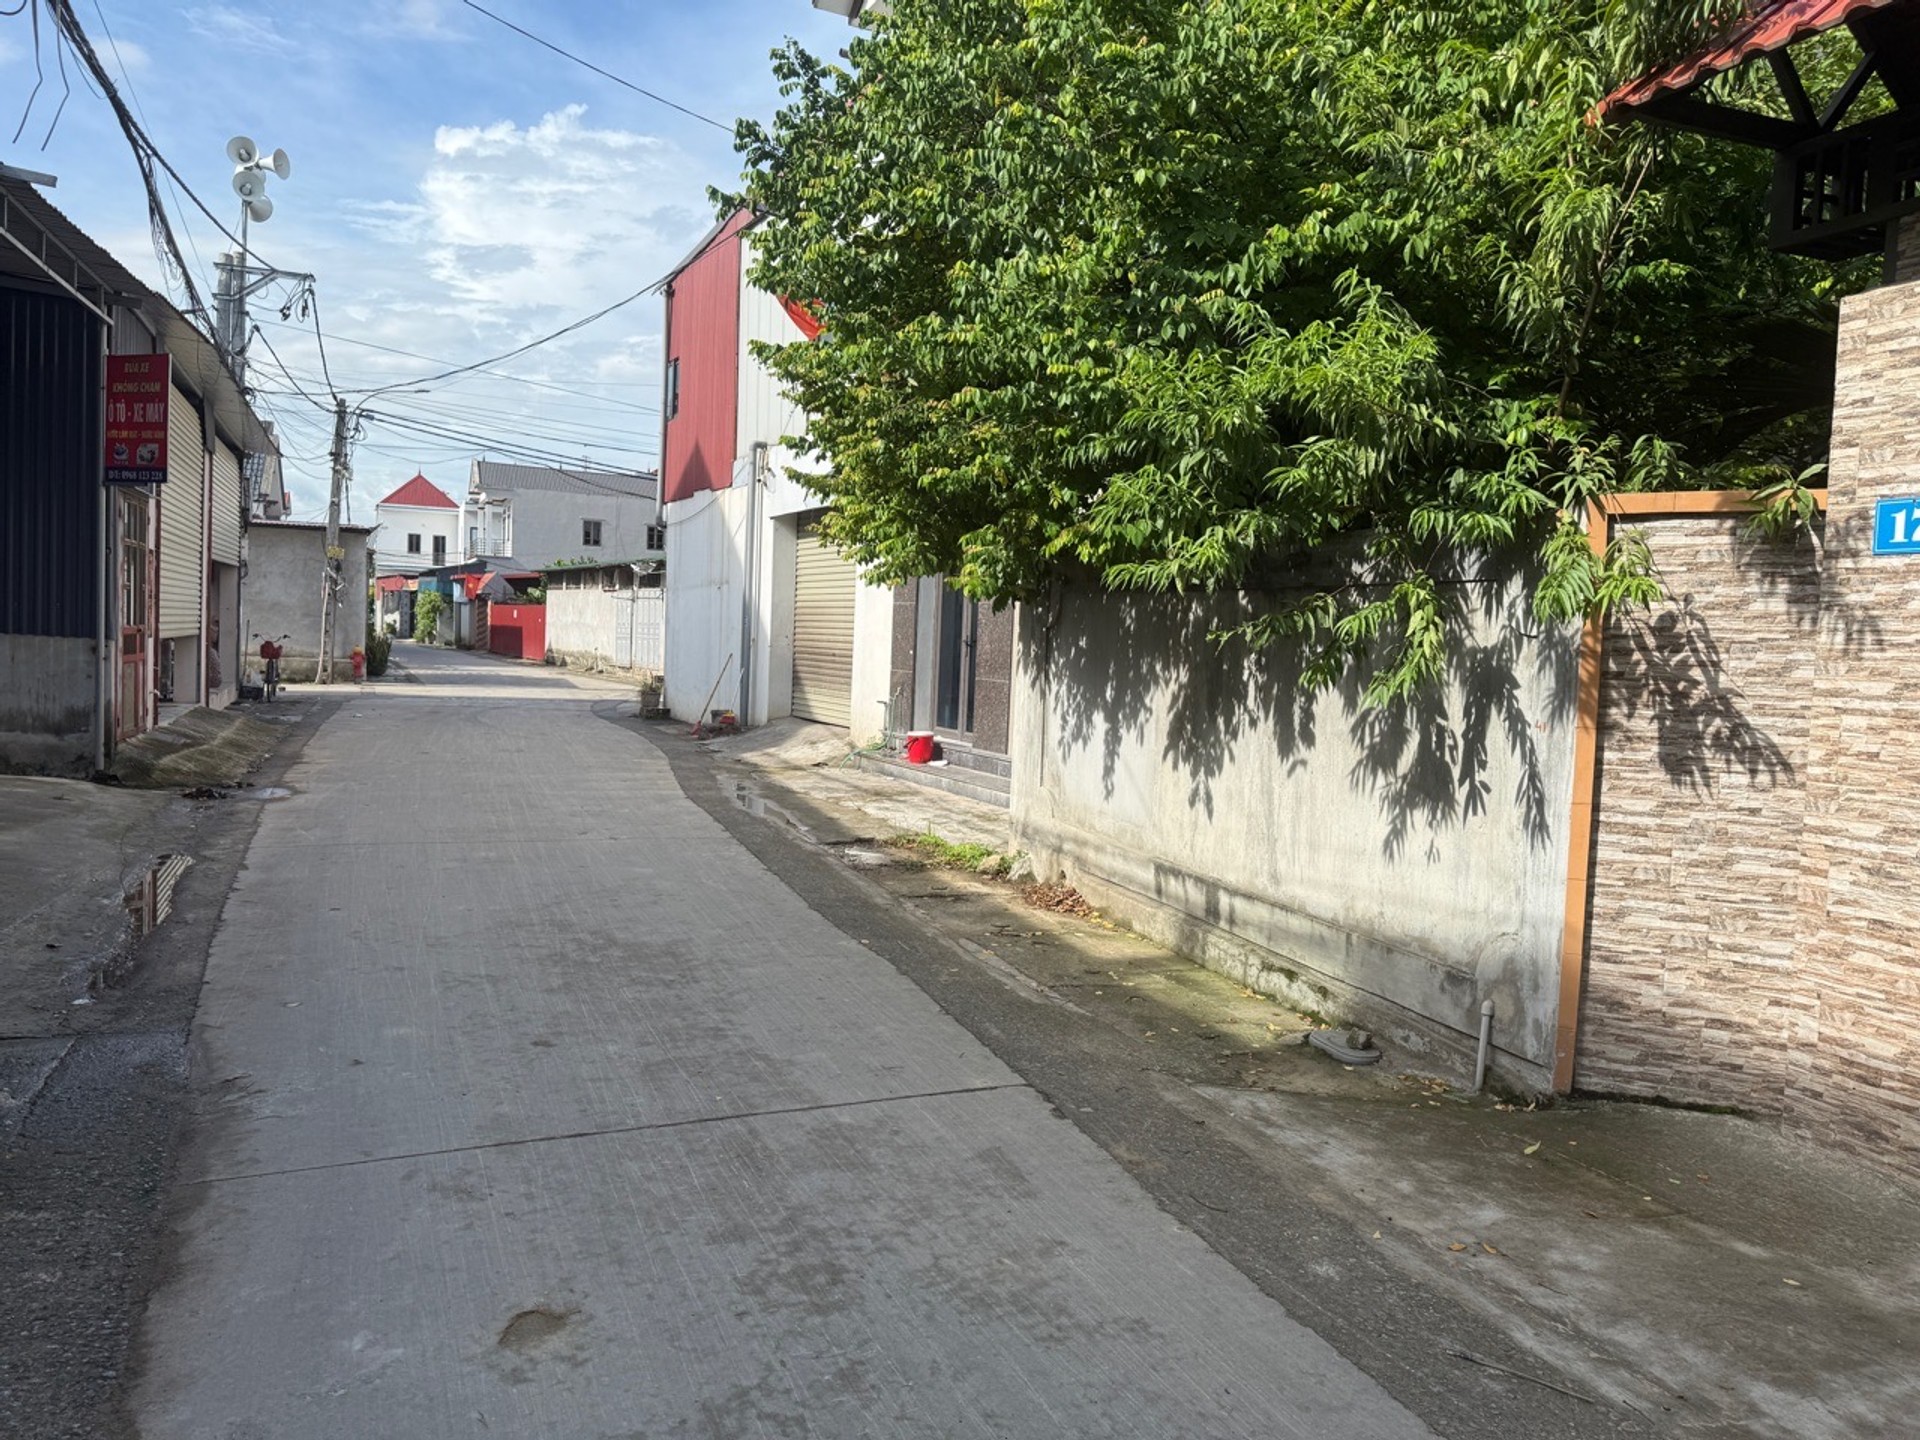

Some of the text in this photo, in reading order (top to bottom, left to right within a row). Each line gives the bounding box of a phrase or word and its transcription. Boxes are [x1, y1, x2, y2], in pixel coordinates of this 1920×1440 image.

[140, 362, 150, 373] XE
[112, 379, 139, 393] KHÔNG
[108, 398, 114, 423] Ô
[115, 398, 126, 423] TÔ
[133, 402, 144, 423] XE
[145, 398, 165, 423] MÁY
